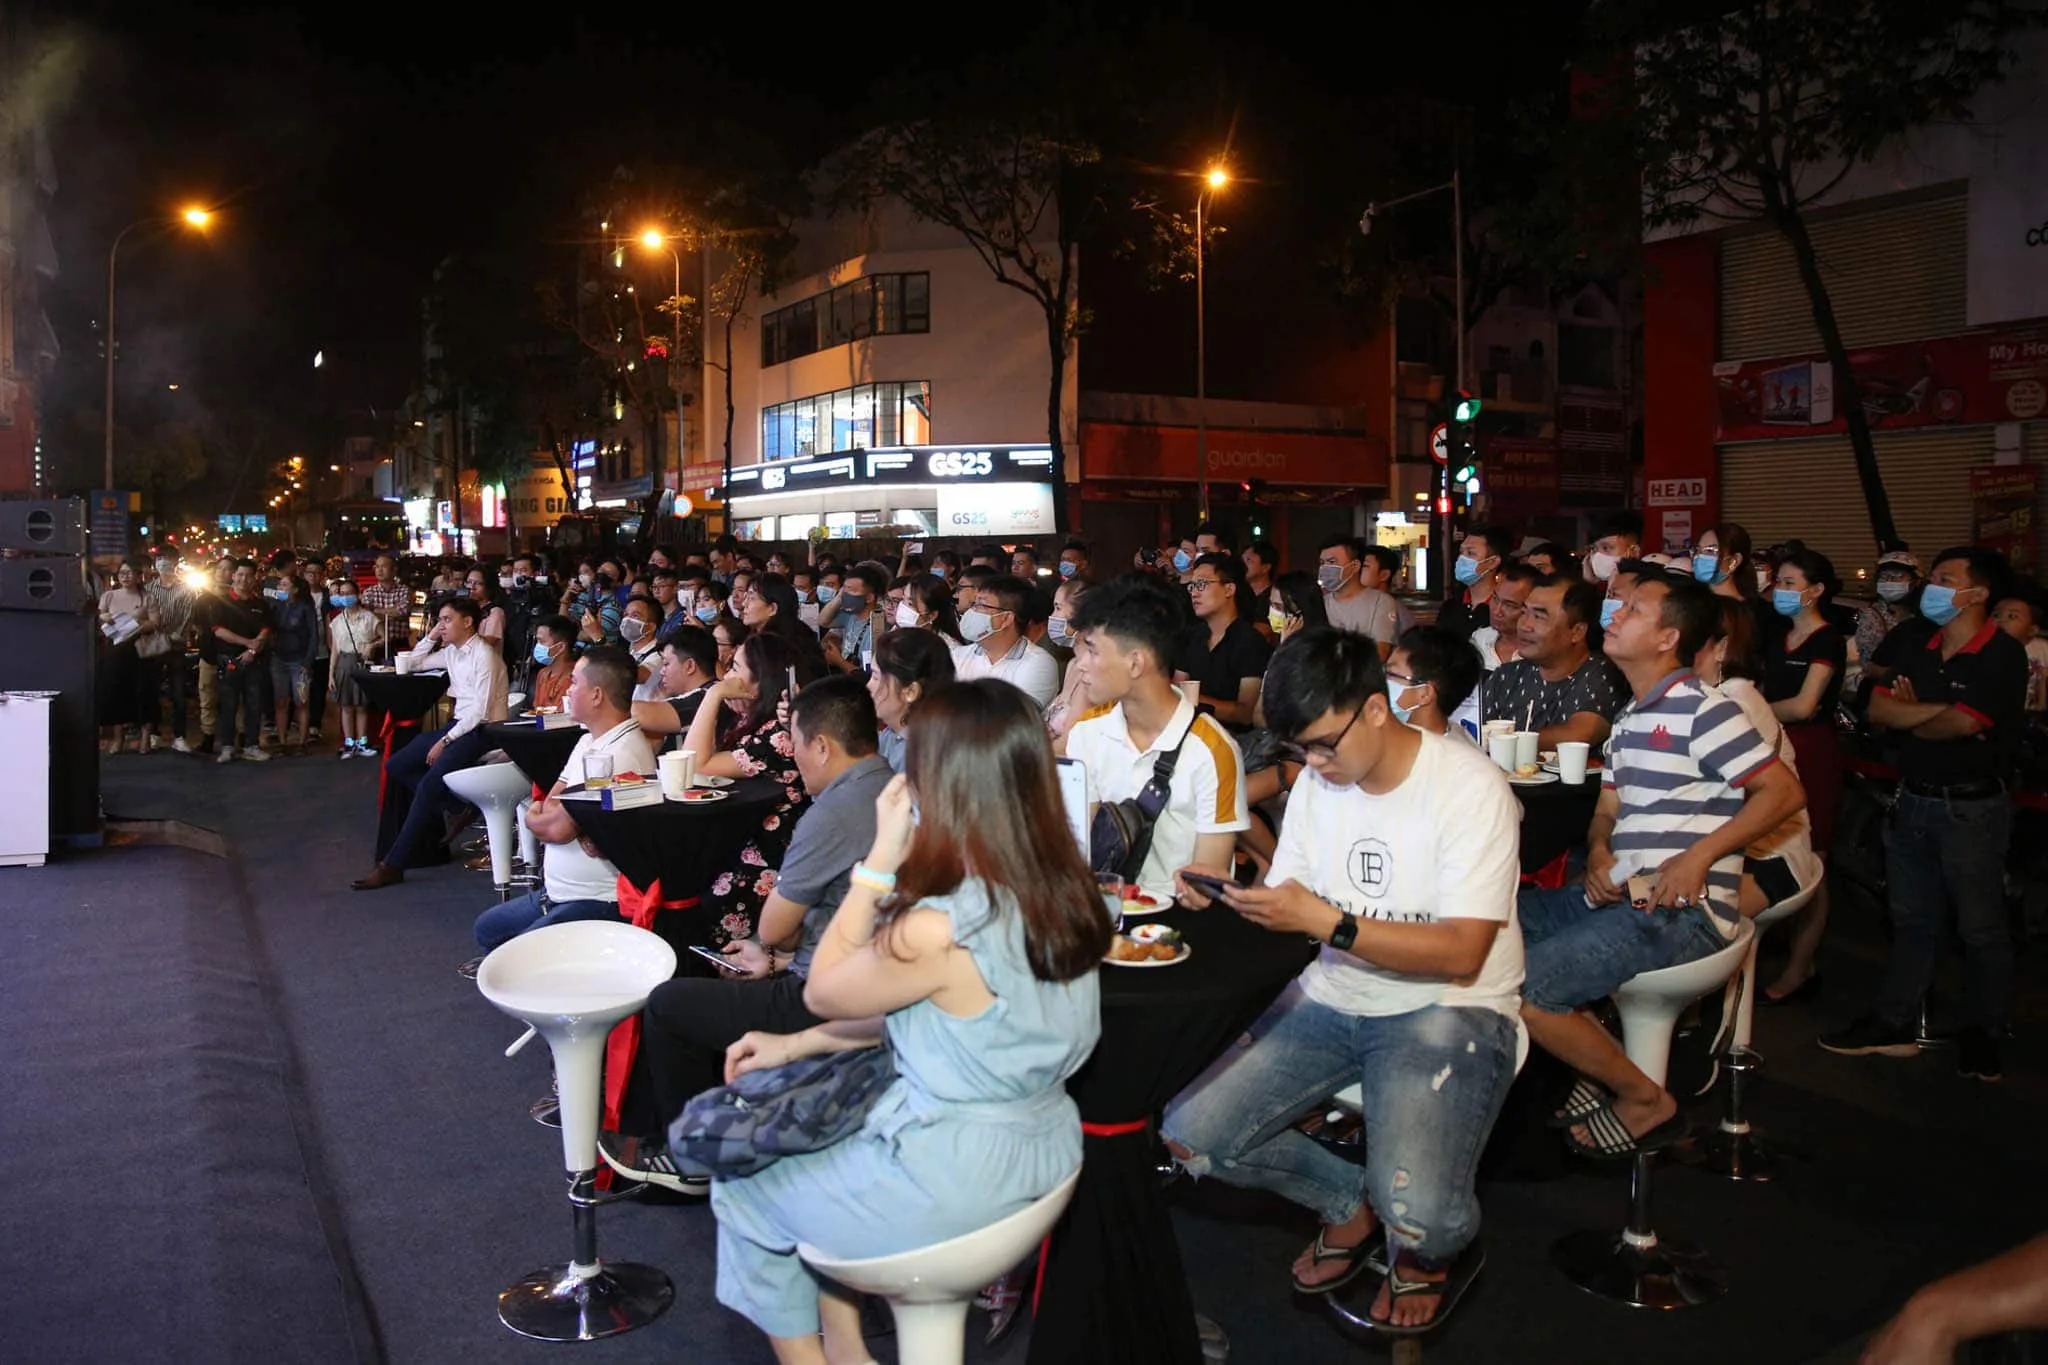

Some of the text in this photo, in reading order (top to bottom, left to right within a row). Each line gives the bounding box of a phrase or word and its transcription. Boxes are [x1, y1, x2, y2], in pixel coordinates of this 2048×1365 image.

[1988, 344, 2018, 362] My
[928, 452, 992, 476] GS25
[1207, 448, 1286, 471] guardian
[1651, 483, 1703, 497] HEAD
[952, 511, 987, 525] GS25
[1360, 851, 1383, 884] B
